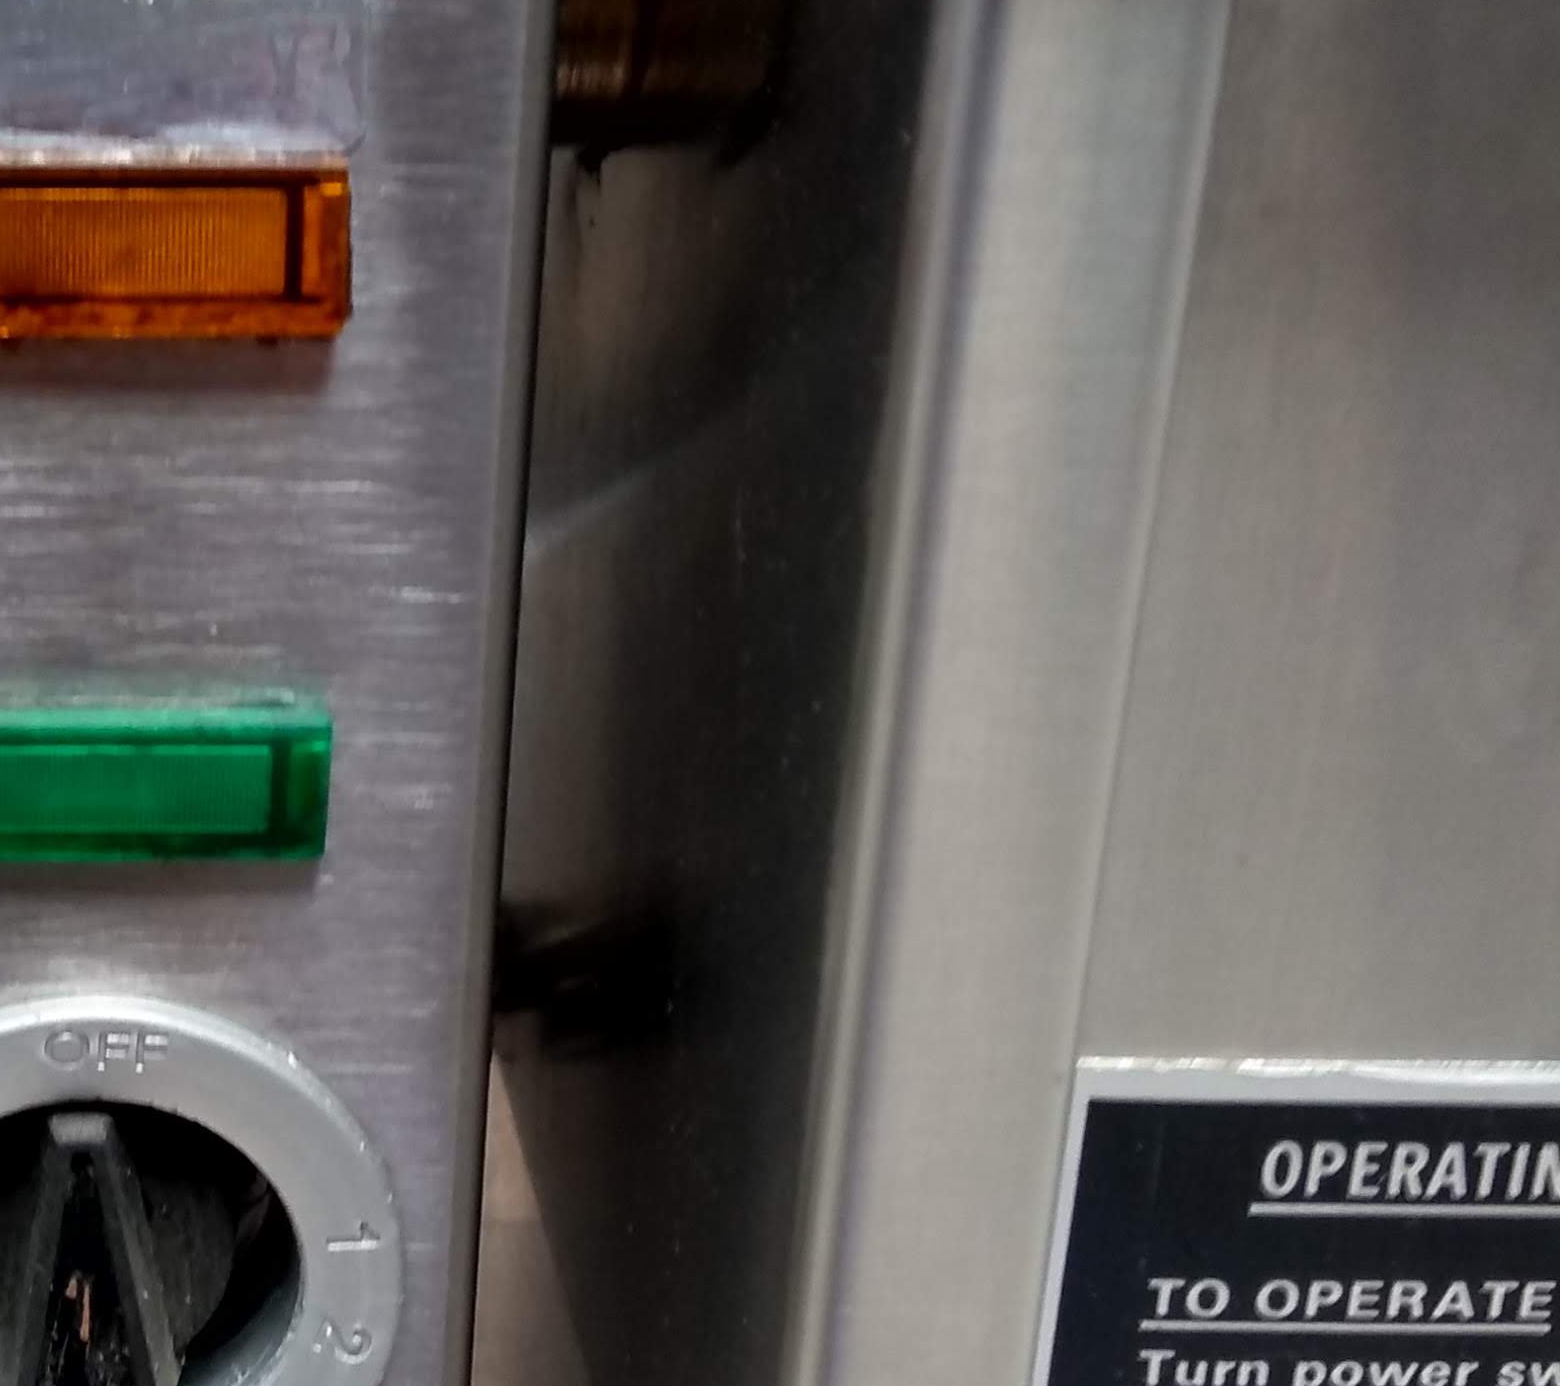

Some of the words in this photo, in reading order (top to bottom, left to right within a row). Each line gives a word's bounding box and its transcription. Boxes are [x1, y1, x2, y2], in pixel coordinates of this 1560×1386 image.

[43, 1030, 168, 1073] OFF
[326, 1221, 380, 1253] 1
[1146, 1276, 1232, 1319] TO
[1253, 1277, 1559, 1321] OPERATE
[313, 1318, 373, 1365] 2
